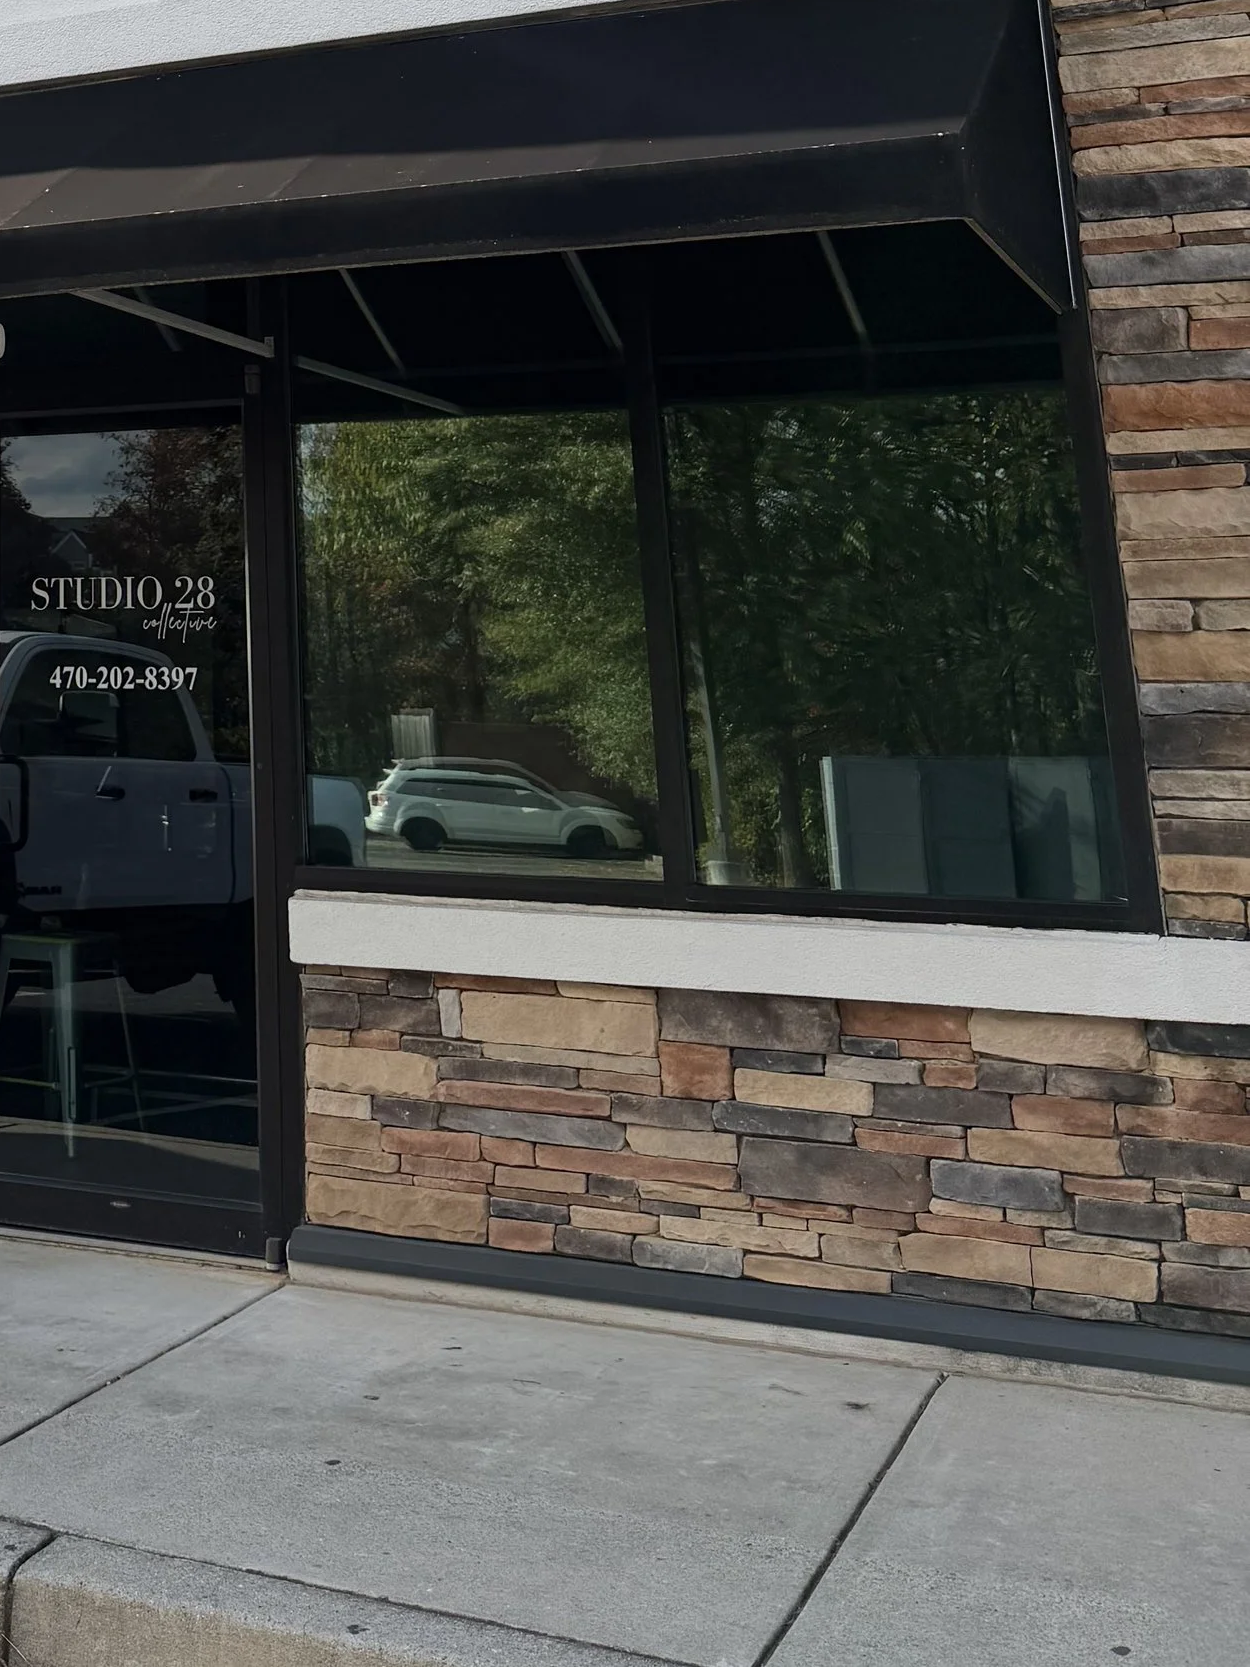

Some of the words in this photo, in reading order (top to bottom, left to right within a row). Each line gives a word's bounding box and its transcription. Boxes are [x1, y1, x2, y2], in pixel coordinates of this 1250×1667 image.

[30, 575, 163, 612] STUDIO
[174, 575, 216, 610] 28
[142, 602, 218, 644] collective
[49, 665, 199, 691] 470-202-8397
